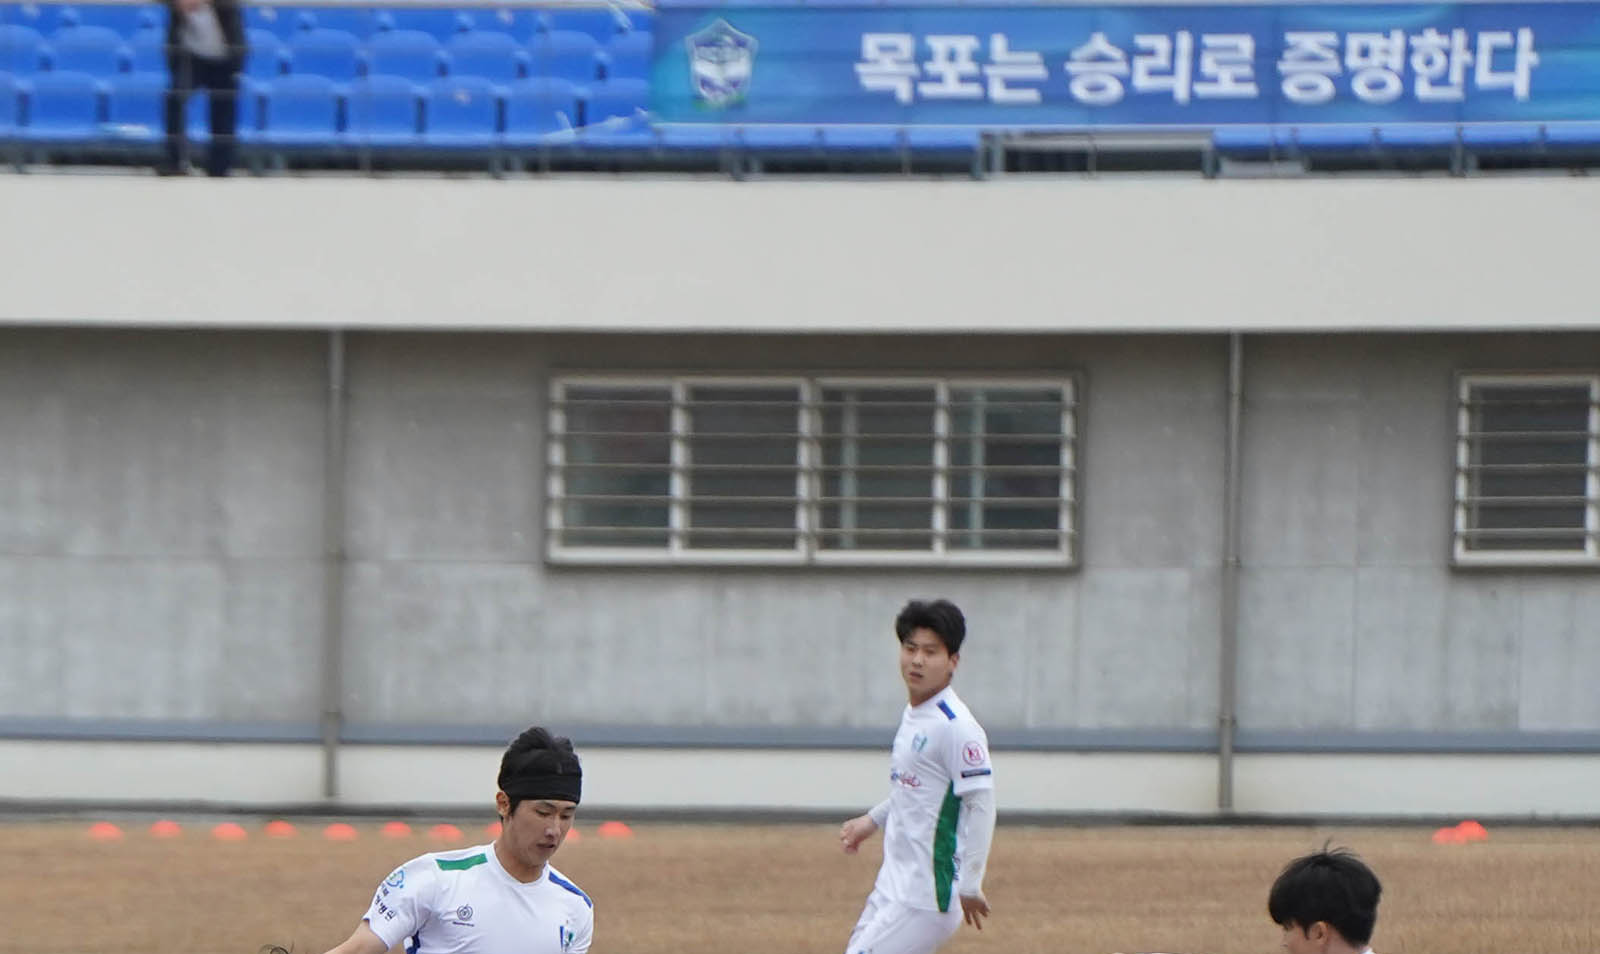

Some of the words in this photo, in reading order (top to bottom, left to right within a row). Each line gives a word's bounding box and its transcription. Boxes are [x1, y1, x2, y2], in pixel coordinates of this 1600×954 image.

[855, 32, 1048, 102] 목포는
[1064, 30, 1259, 103] 승리로
[1277, 27, 1540, 103] 증명한다
